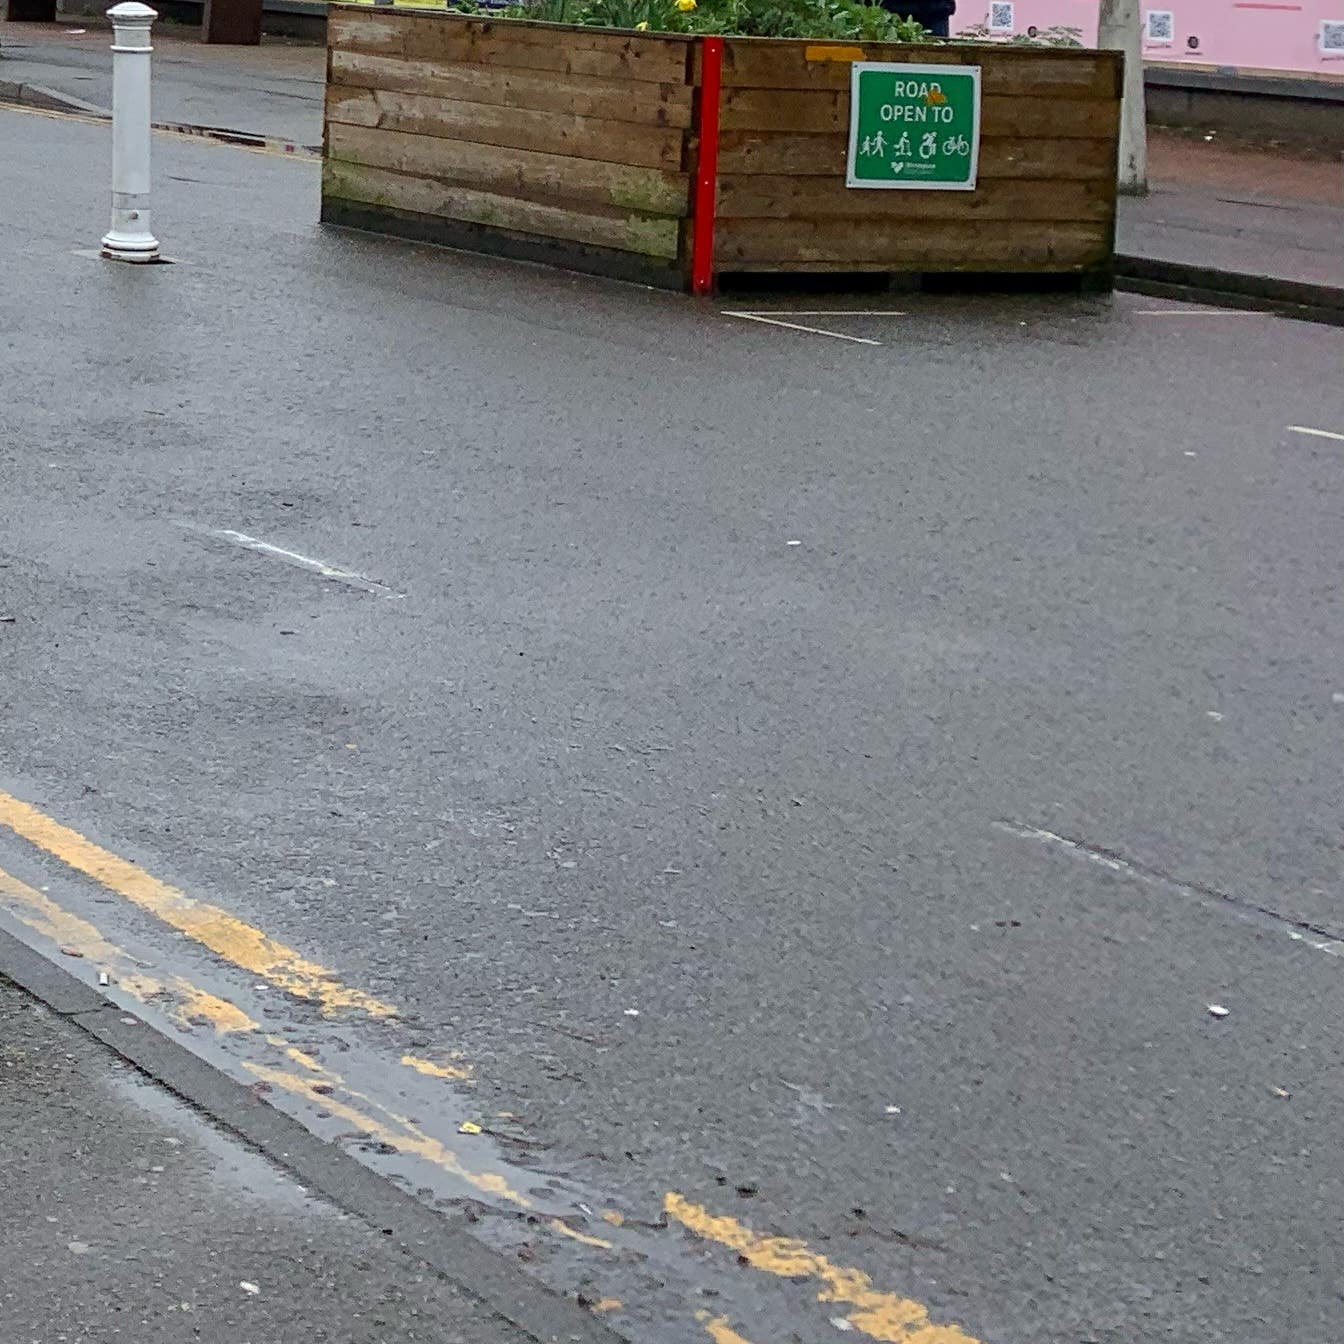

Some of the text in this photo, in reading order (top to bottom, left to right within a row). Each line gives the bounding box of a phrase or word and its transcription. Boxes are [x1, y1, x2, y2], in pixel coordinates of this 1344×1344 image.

[895, 81, 942, 99] ROAD
[880, 104, 954, 124] OPEN TO
